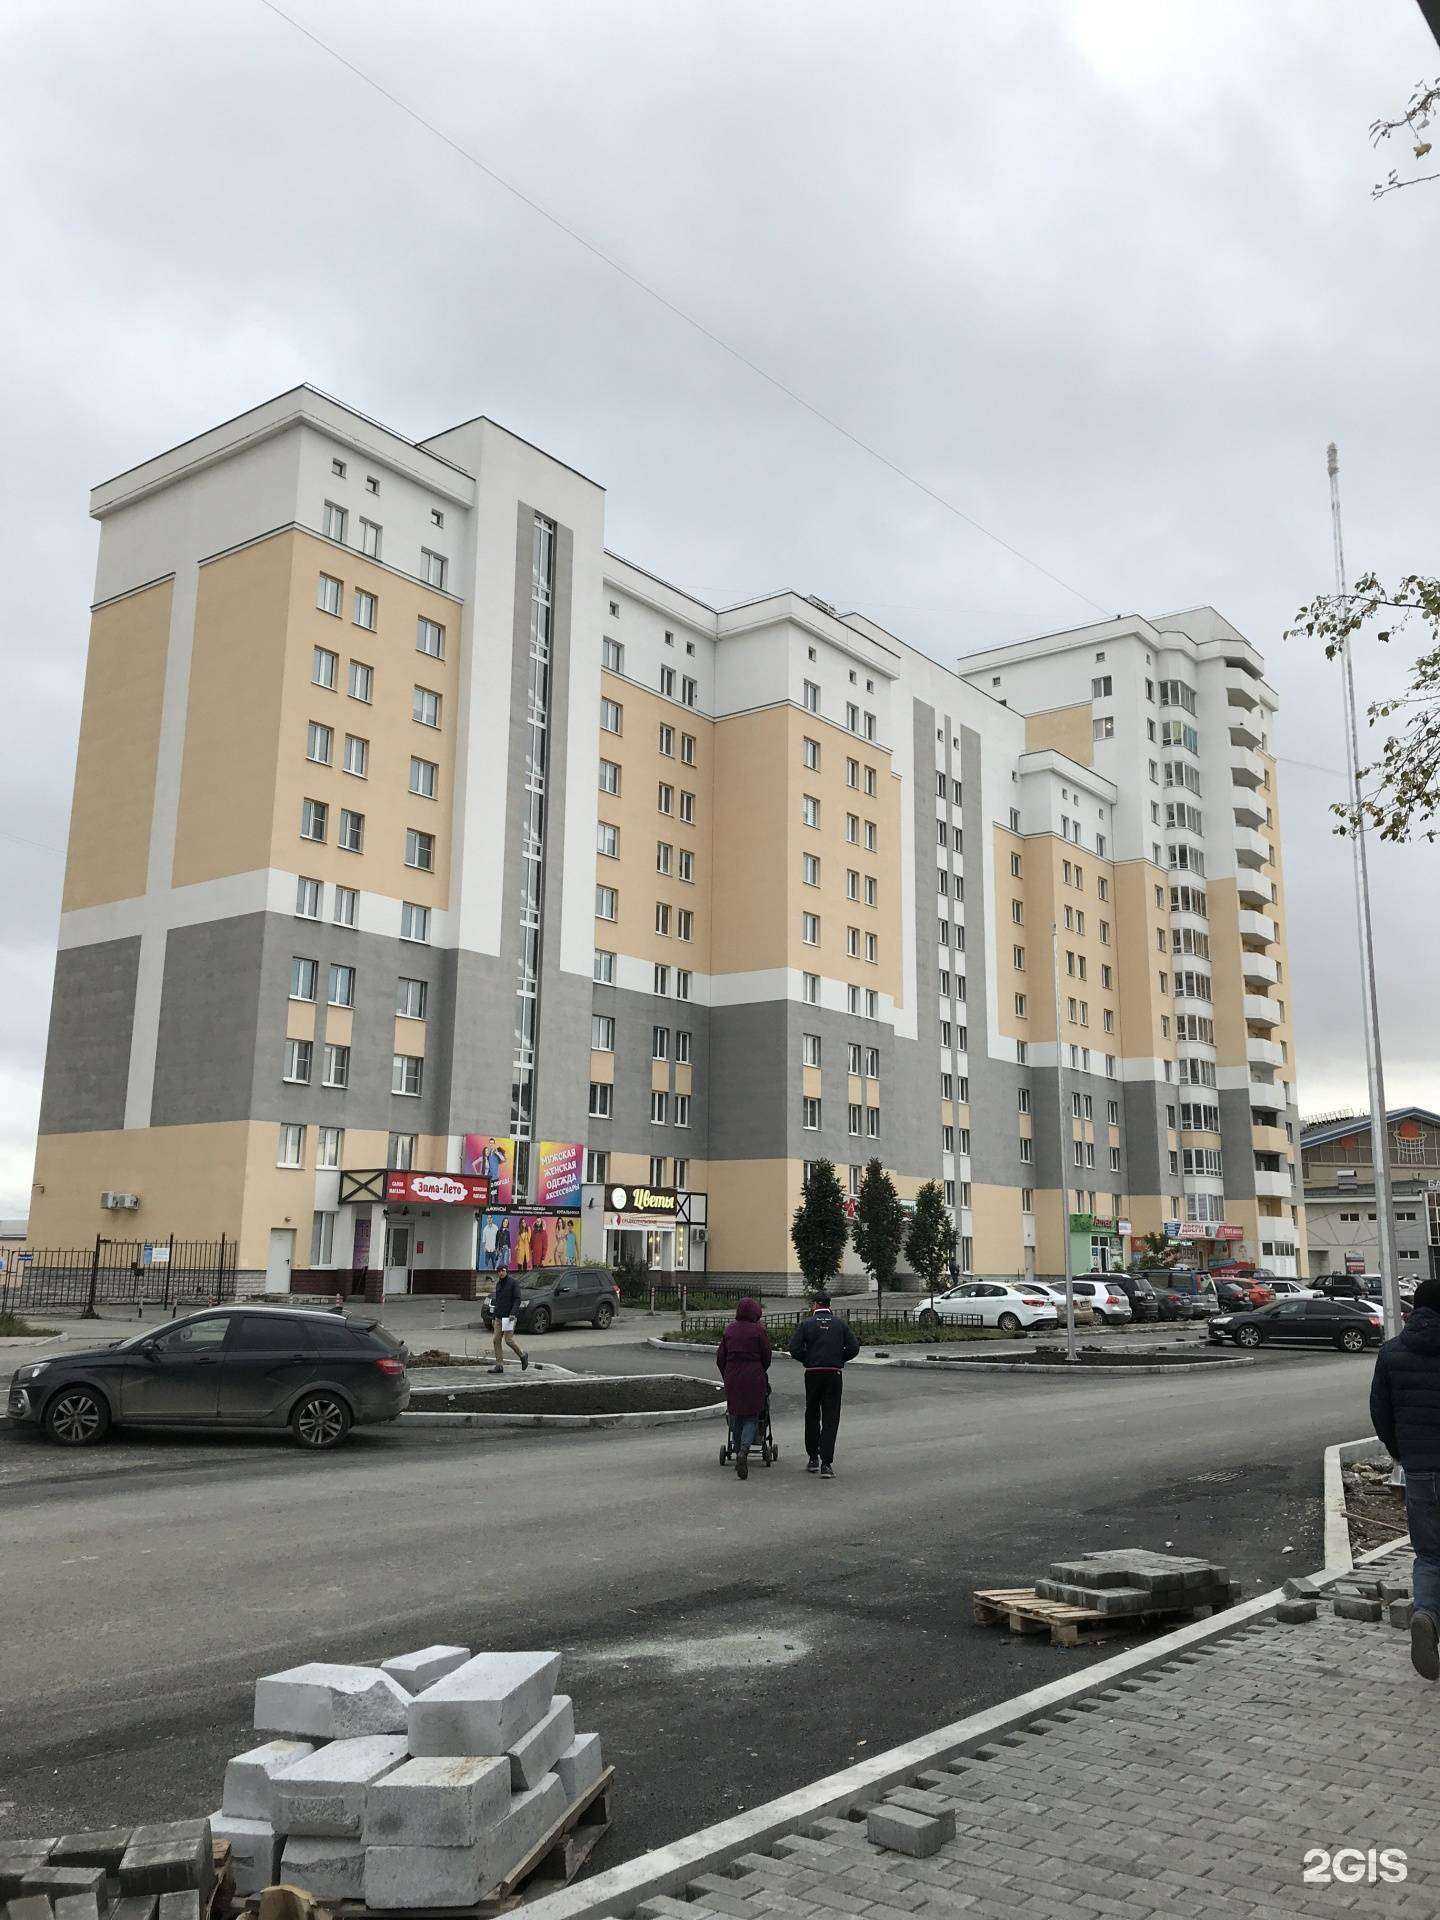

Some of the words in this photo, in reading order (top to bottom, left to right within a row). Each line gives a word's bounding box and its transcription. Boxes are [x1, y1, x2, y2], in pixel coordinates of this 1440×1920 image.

[541, 1148, 576, 1165] МУЖСКАЯ
[544, 1160, 577, 1177] ЖЕНСКАЯ
[418, 1182, 462, 1195] Зима-Лето
[546, 1173, 577, 1189] ОДЕЖДА
[545, 1183, 580, 1200] АКСЕССУАРЫ
[633, 1188, 675, 1210] Цветы
[1182, 1222, 1204, 1233] ДВЕРИ
